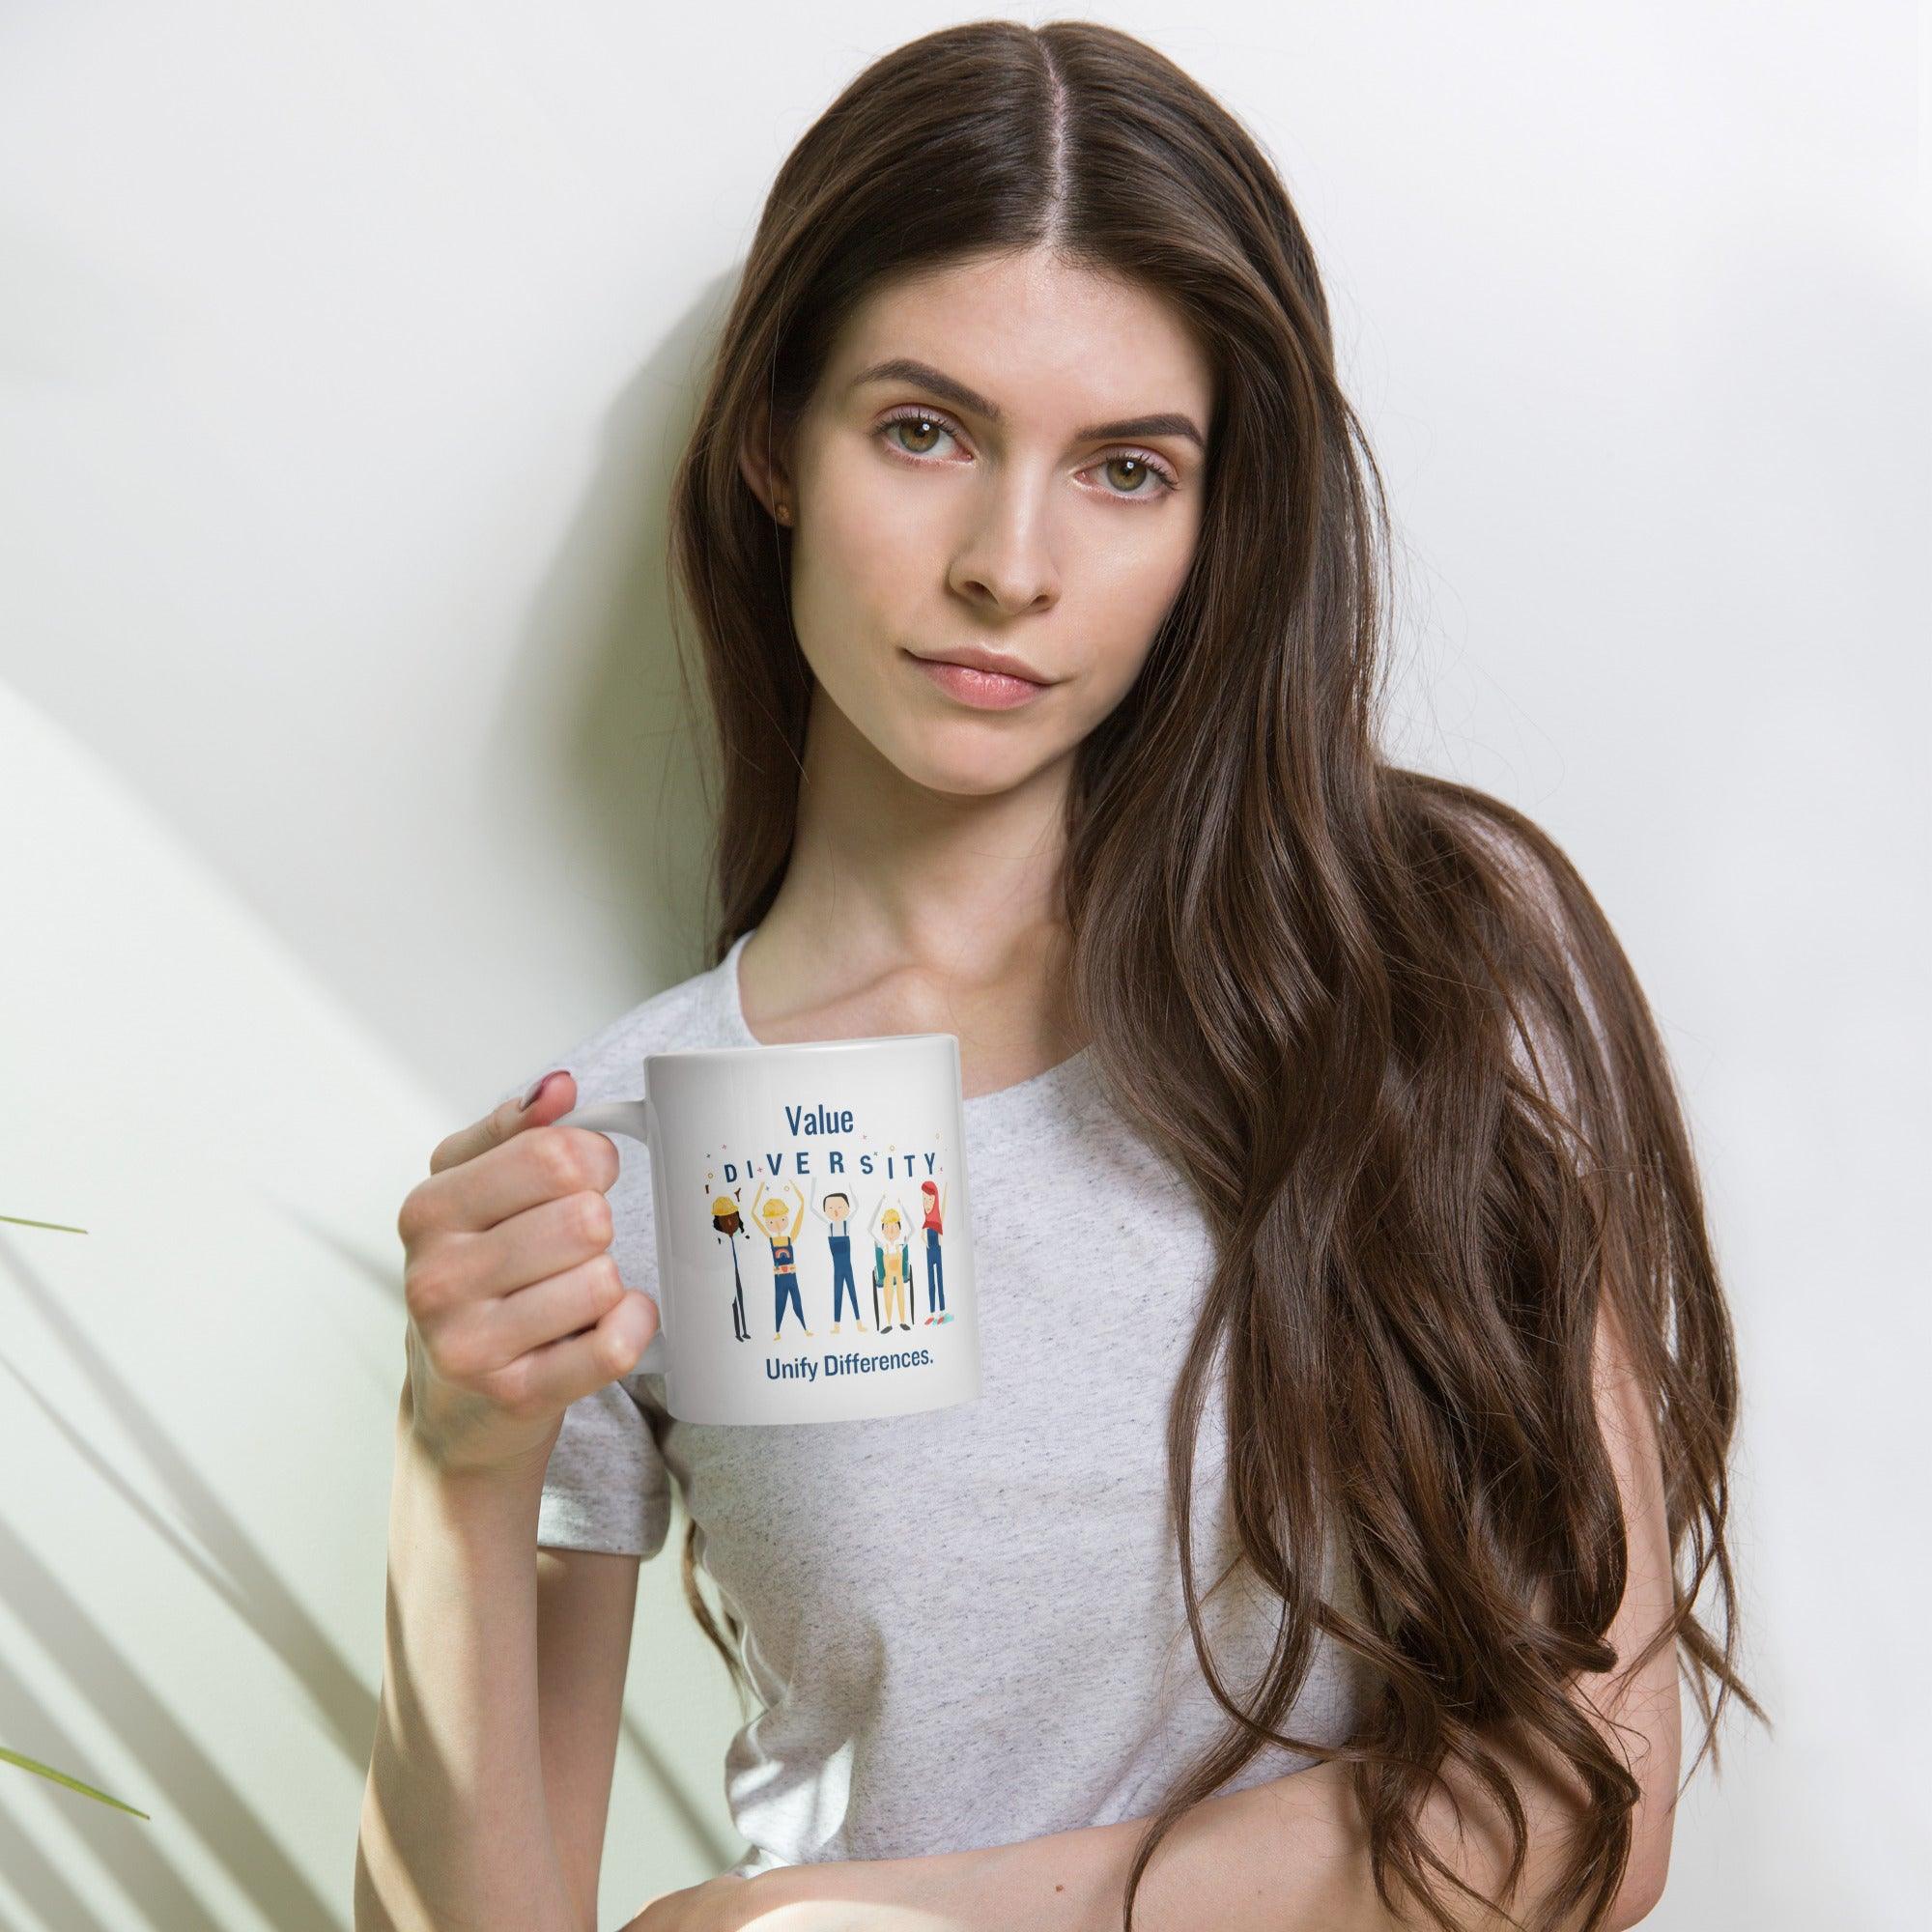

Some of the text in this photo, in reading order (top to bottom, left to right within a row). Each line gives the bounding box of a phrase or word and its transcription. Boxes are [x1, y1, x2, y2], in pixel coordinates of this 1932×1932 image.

[784, 1104, 854, 1137] Value
[724, 1151, 936, 1183] DIVERSITY
[766, 1350, 934, 1382] Unify Differences.
